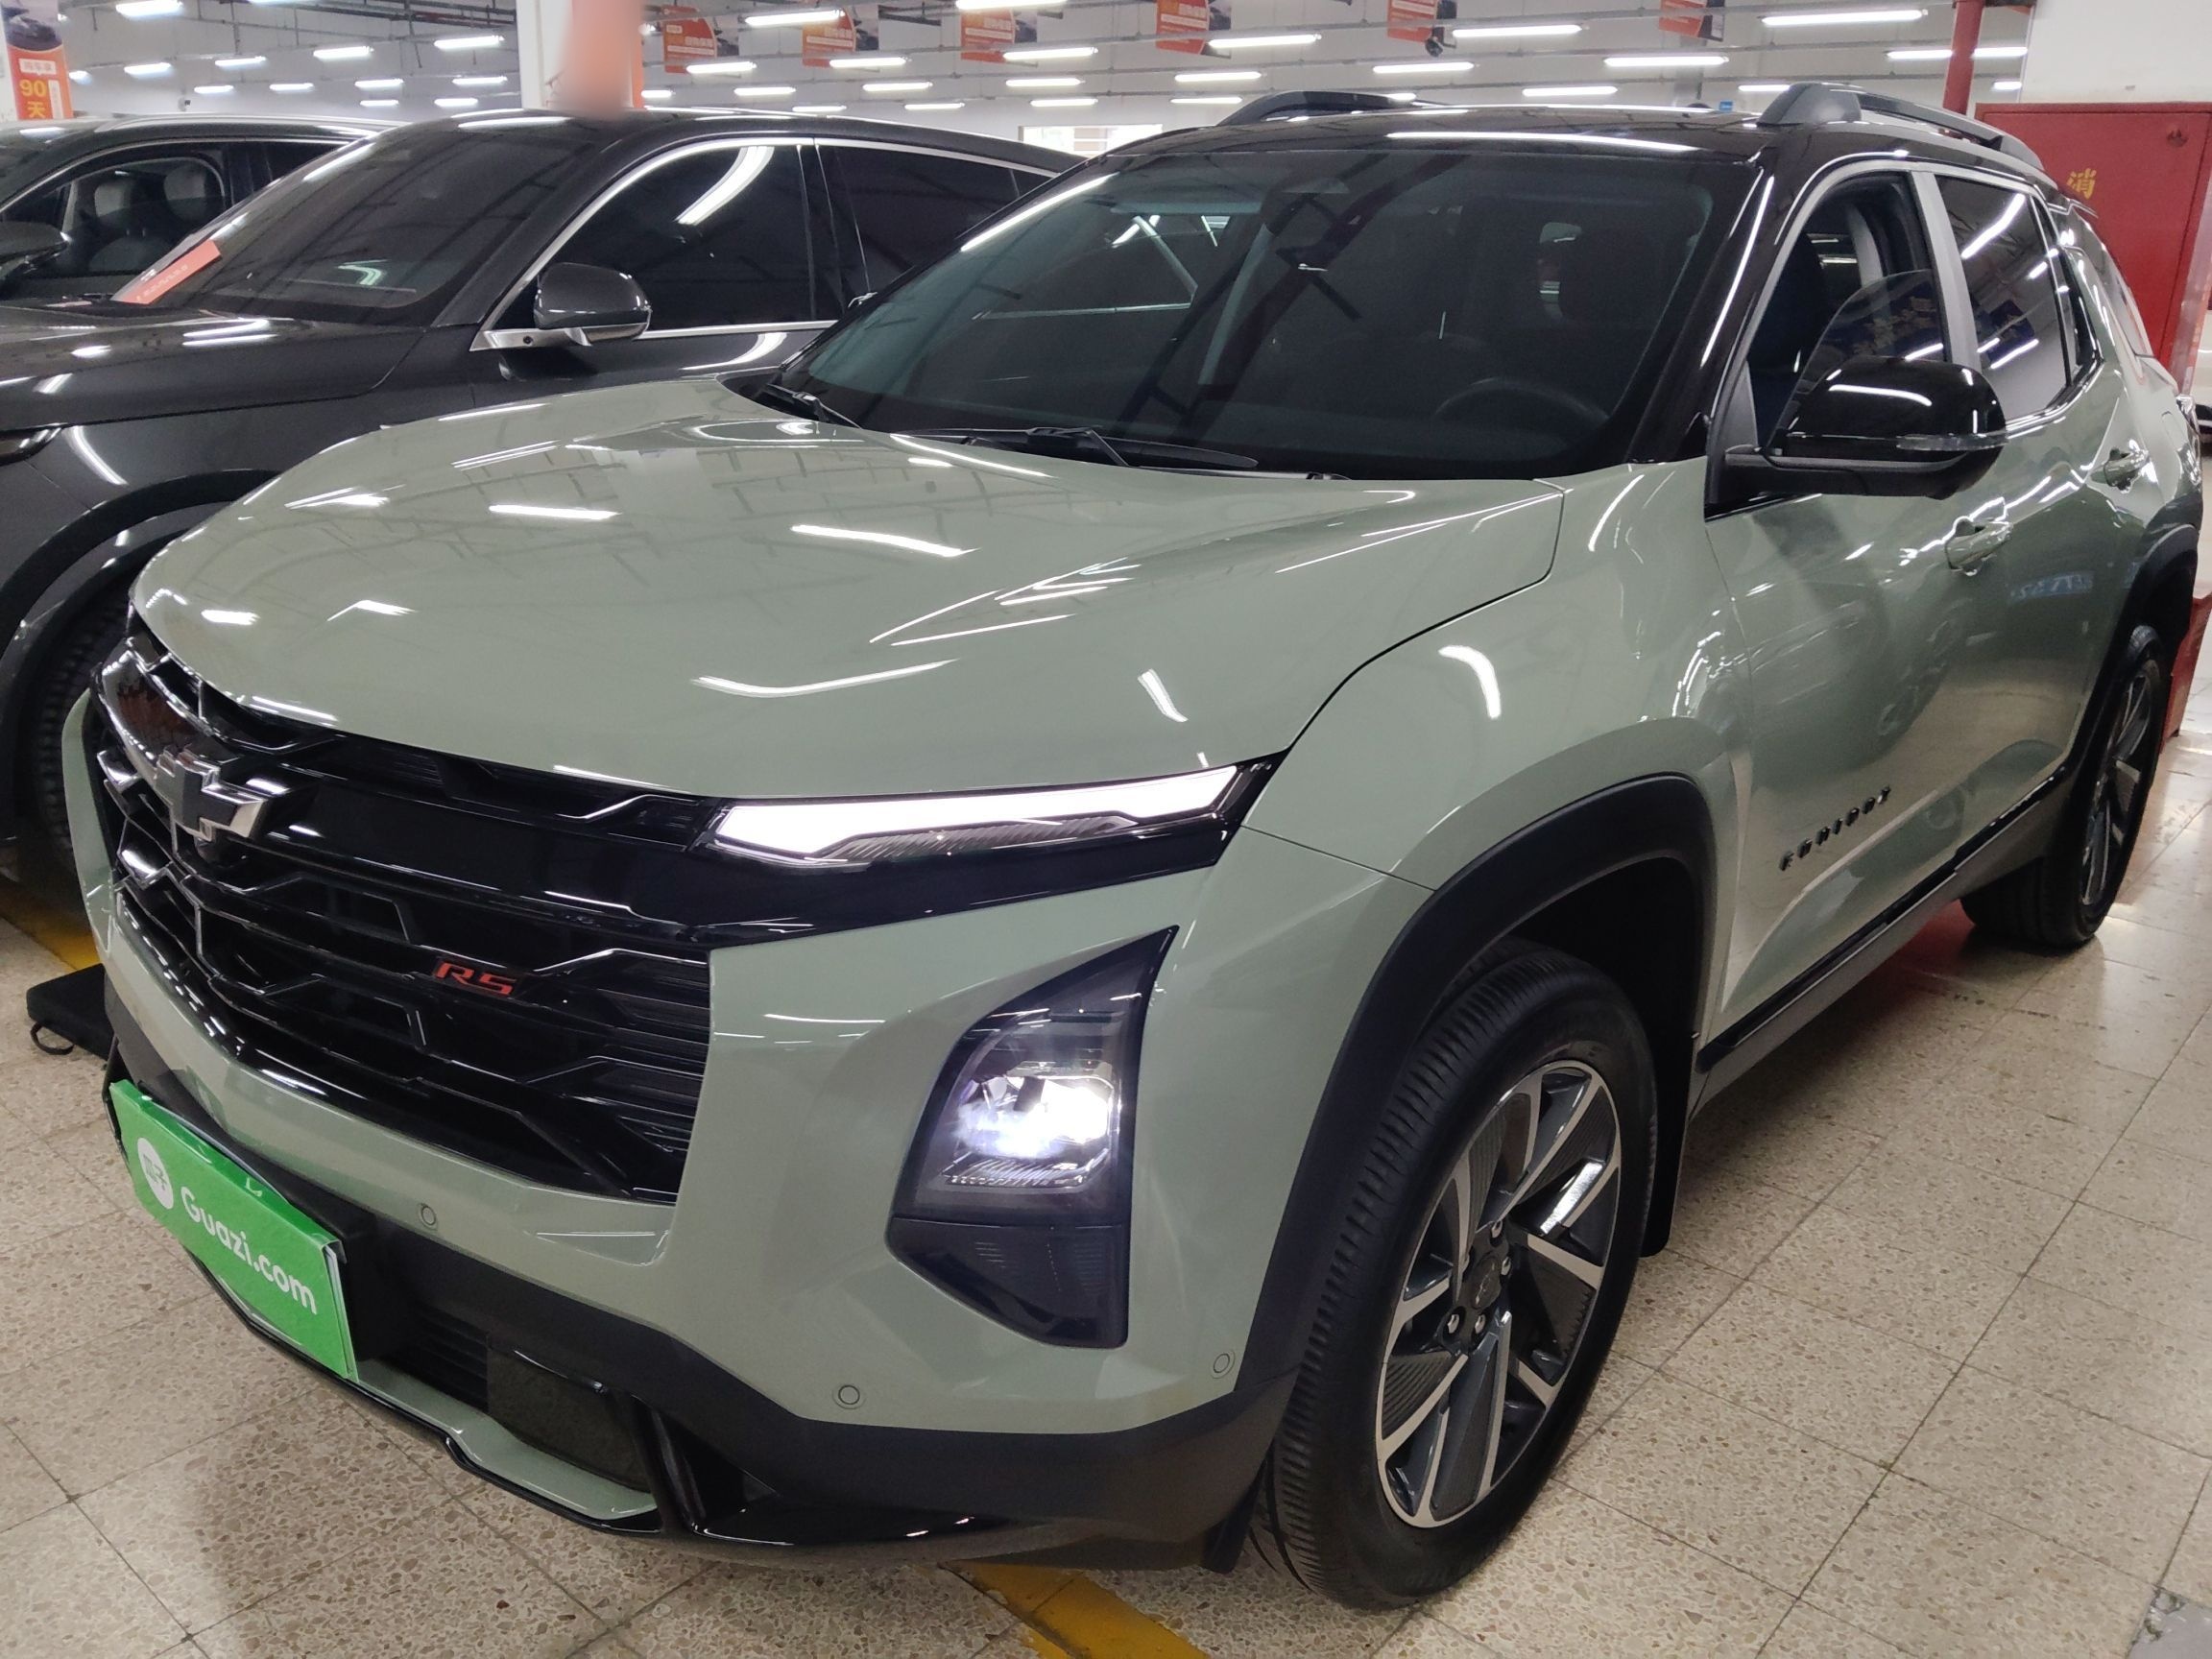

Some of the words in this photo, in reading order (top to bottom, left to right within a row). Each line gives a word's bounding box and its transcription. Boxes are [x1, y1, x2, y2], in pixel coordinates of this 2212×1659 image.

[19, 79, 47, 98] 90
[27, 100, 46, 118] 天
[2066, 167, 2097, 200] 消
[436, 962, 517, 996] RS
[180, 1186, 317, 1315] Guazi.com
